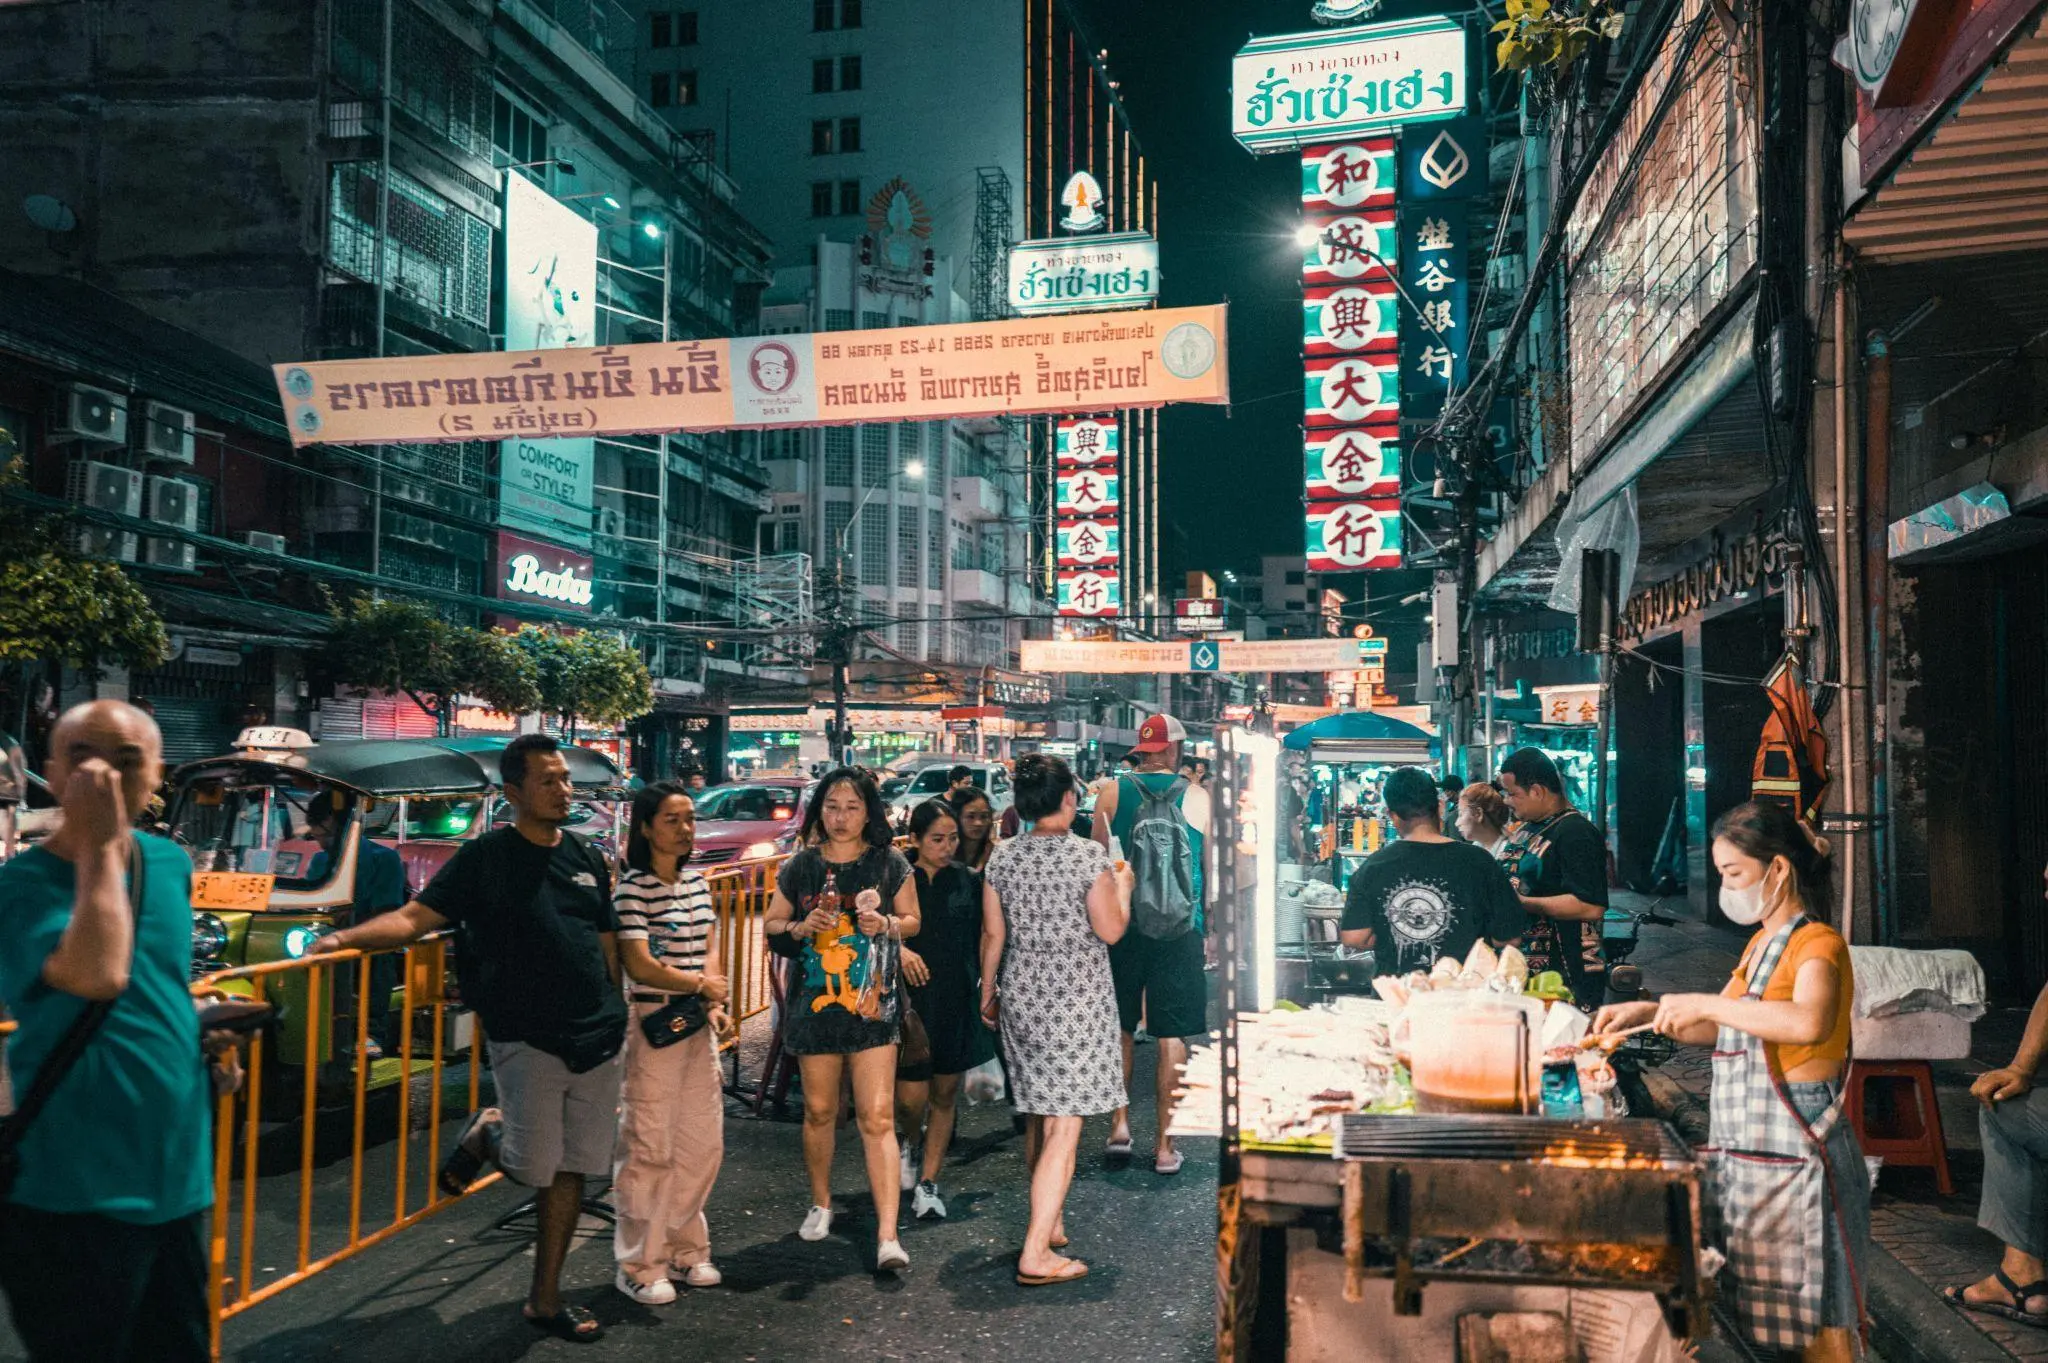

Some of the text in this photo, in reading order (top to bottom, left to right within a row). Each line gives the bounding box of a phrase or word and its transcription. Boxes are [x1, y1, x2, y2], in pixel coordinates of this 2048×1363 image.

[1291, 50, 1400, 74] หางขายทอง
[1246, 67, 1453, 127] ฮั่วเซ่งเฮง
[1019, 261, 1151, 300] ฮั่วเซ่งเฮง
[1414, 216, 1457, 379] 盤谷銀行
[1324, 152, 1376, 559] 和成興大金行
[518, 443, 580, 479] COMFORT
[533, 472, 576, 501] STYLE?
[507, 554, 593, 605] Bata
